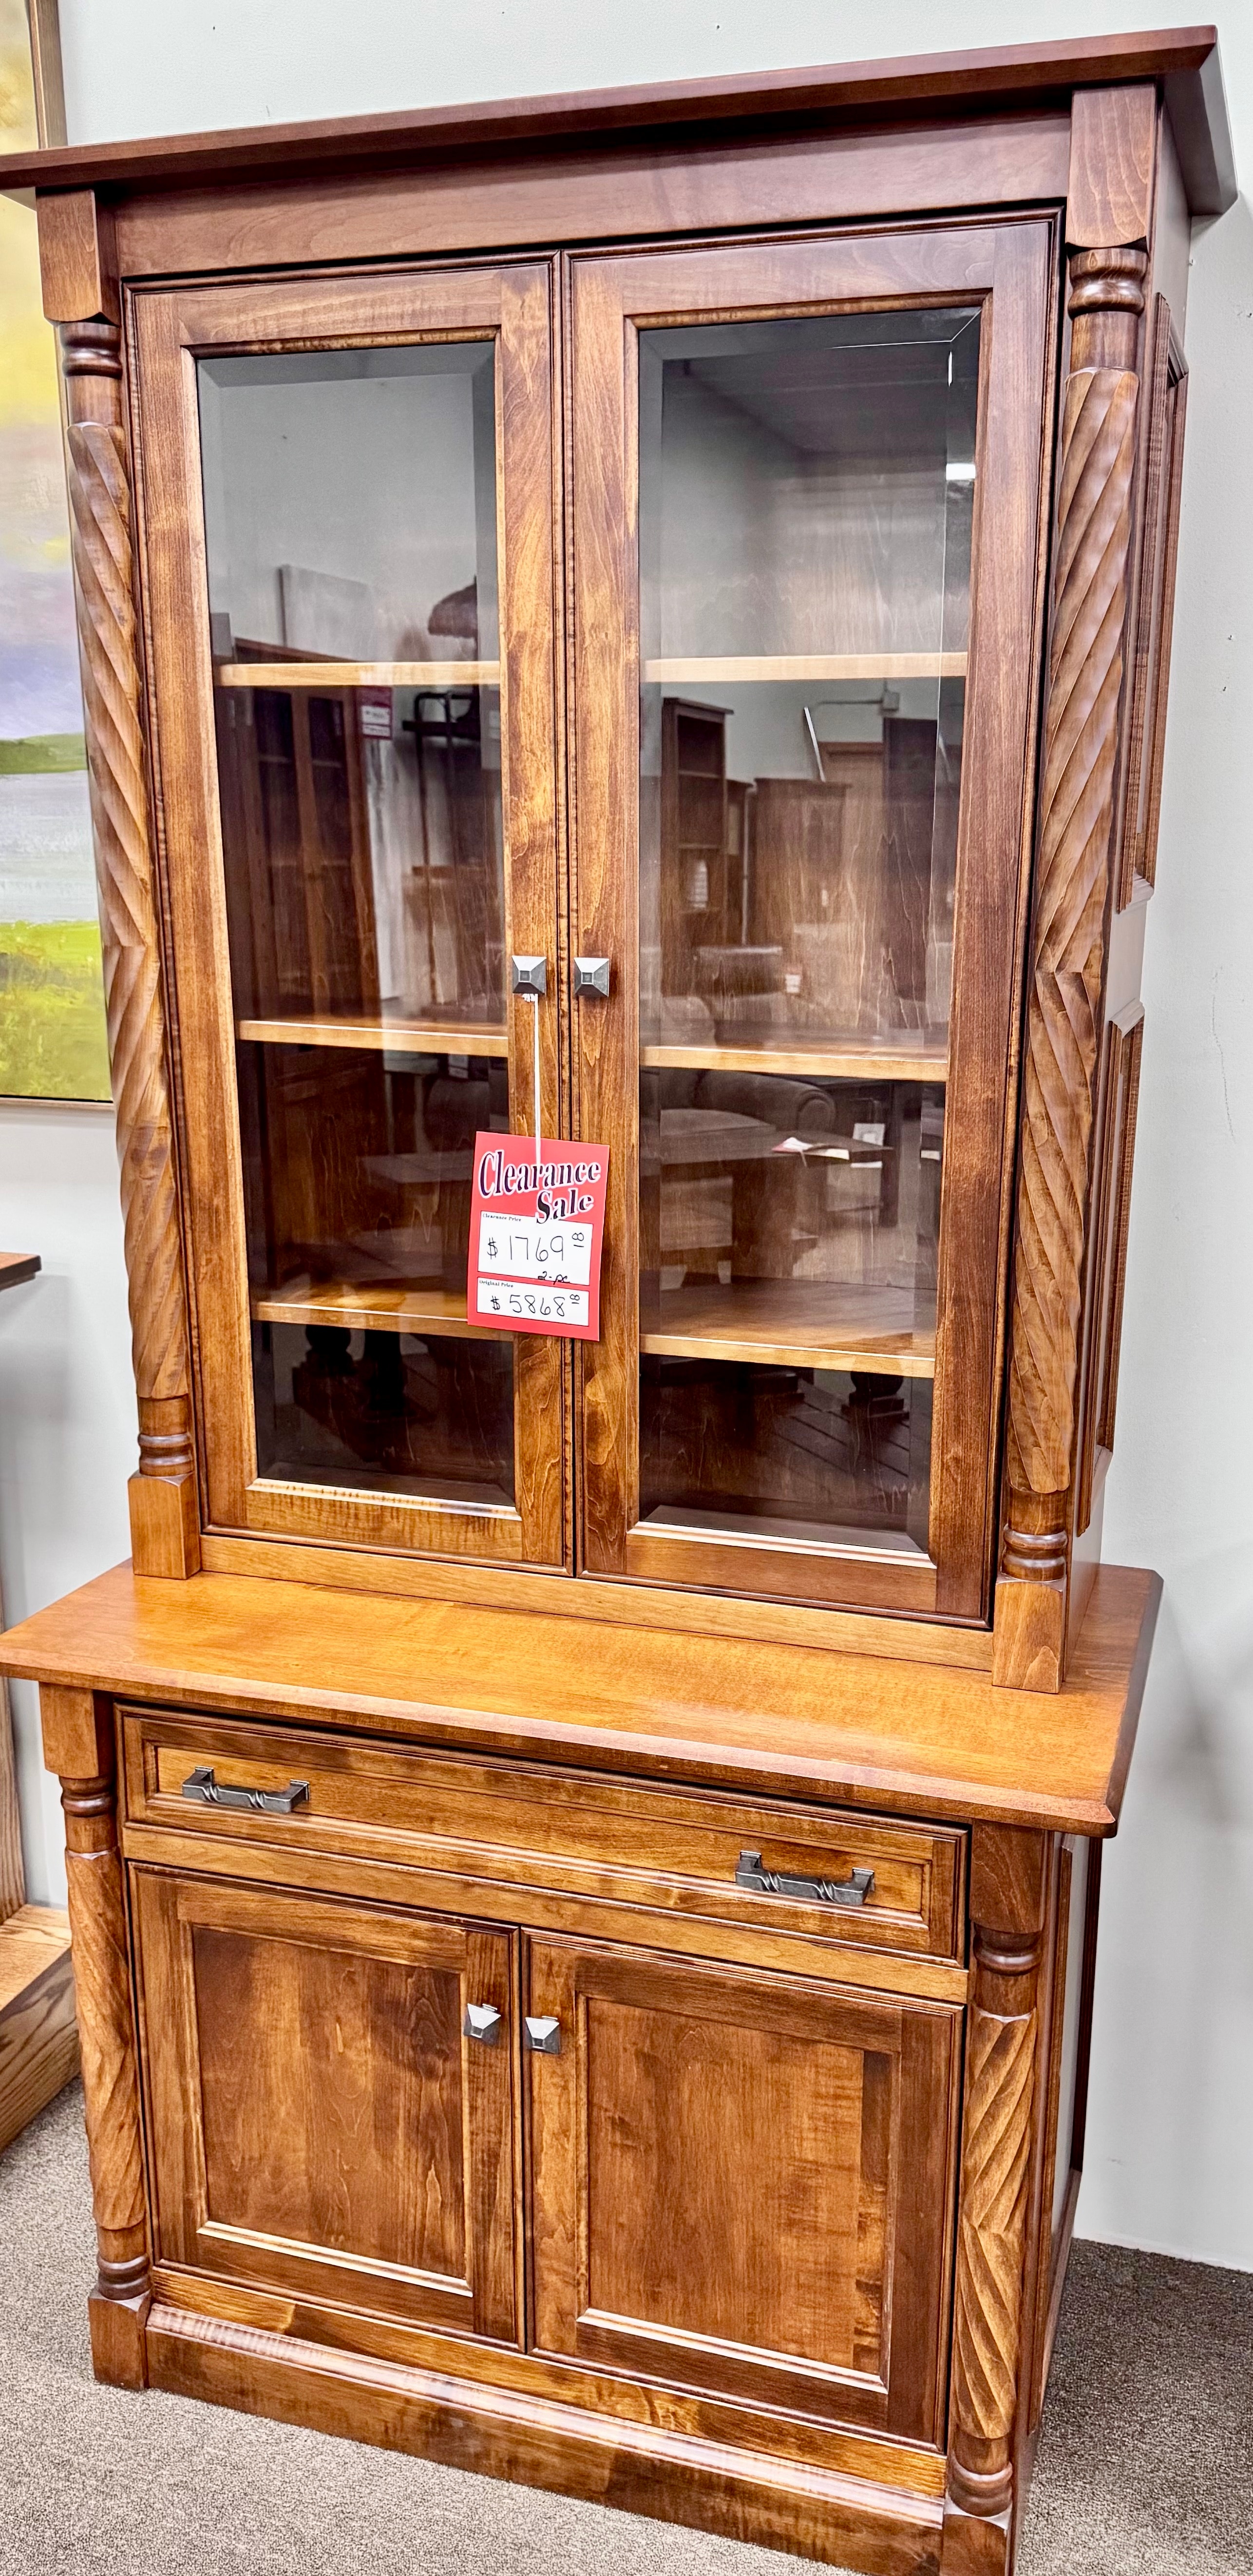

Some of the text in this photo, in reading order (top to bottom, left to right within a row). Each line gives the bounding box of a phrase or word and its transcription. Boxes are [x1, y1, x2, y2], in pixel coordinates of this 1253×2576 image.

[478, 1149, 602, 1199] Clearance
[536, 1187, 595, 1224] Sale
[487, 1237, 498, 1260] $
[510, 1235, 564, 1262] 1769
[491, 1295, 500, 1311] $
[510, 1295, 566, 1316] 5868
